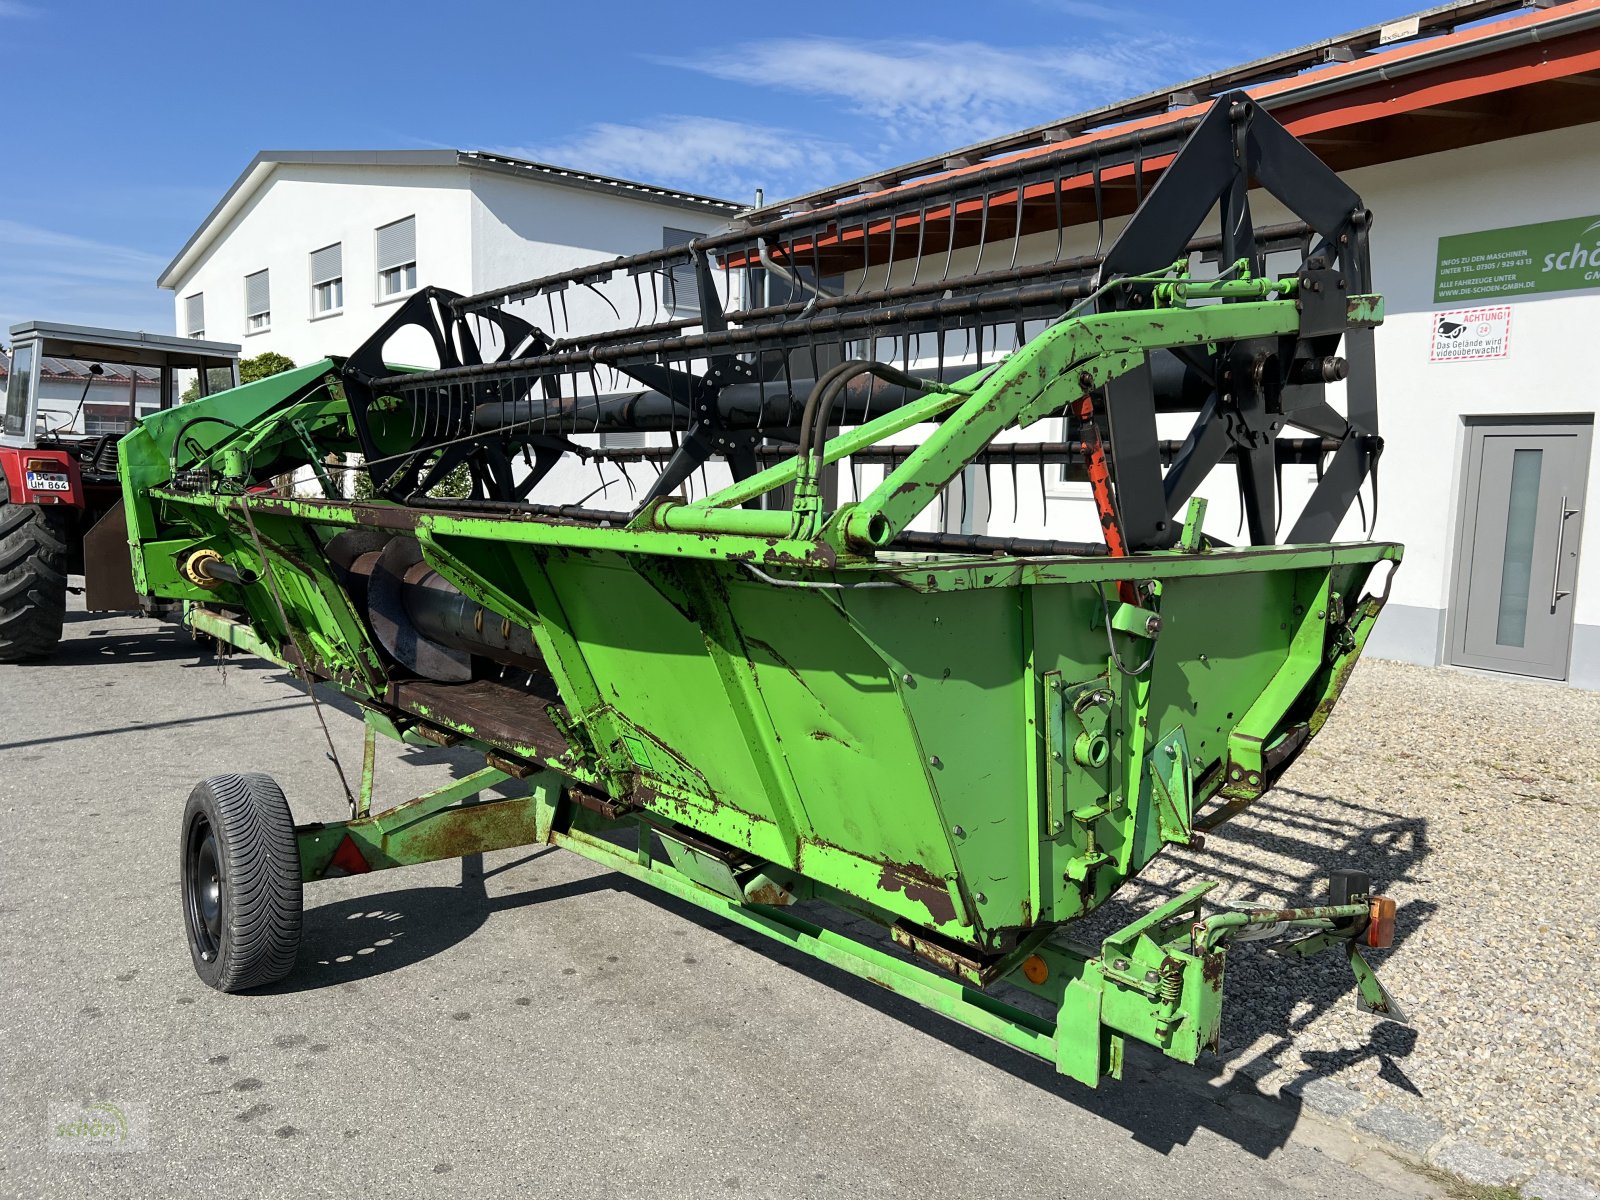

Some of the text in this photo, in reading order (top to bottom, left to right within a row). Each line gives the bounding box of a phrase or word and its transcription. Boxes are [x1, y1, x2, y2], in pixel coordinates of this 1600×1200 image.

[1441, 258, 1460, 266] INFOS
[1486, 250, 1528, 260] MASCHINEN
[1440, 266, 1461, 275] UNTER
[1454, 277, 1492, 286] FAHRZEUGE
[1494, 274, 1517, 282] UNTER
[1439, 281, 1535, 297] WWW.DIE-SCHOEN-GMBH.DE
[1464, 312, 1506, 322] ACHTUNG!
[1437, 341, 1450, 349] Das
[1452, 339, 1483, 348] Gelände
[1436, 346, 1501, 357] videoüberwacht!
